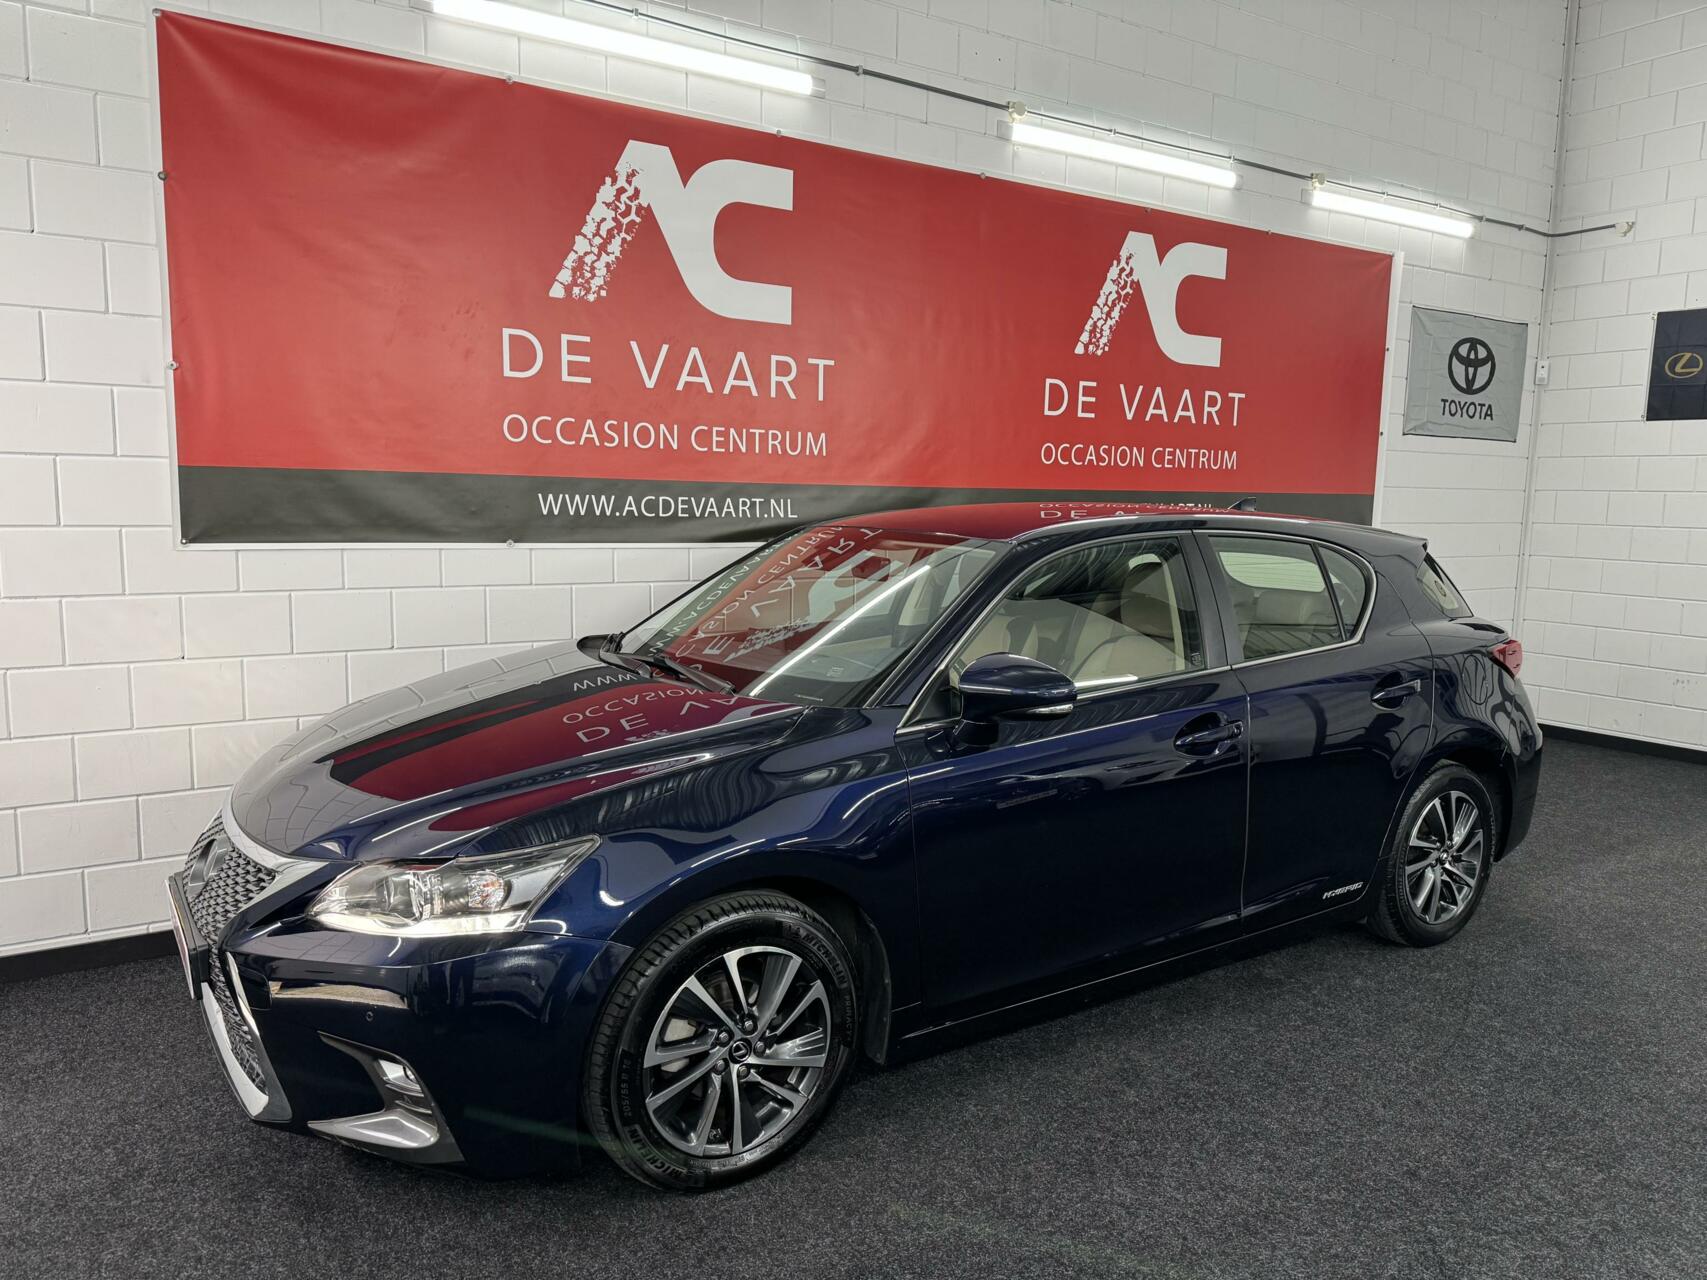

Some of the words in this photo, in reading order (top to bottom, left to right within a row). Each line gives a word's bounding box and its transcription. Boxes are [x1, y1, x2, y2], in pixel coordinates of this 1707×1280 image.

[548, 139, 794, 325] AC
[1074, 230, 1228, 367] AC
[502, 327, 593, 384] DE
[629, 340, 835, 401] VAART
[1043, 377, 1097, 419] DE
[1119, 383, 1246, 427] VAART
[1440, 398, 1494, 421] TOYOTA
[502, 413, 679, 450] OCCASION
[690, 425, 828, 457] CENTRUM
[1040, 442, 1144, 467] OCCASION
[1151, 447, 1237, 470] CENTRUM
[538, 493, 798, 519] WWW.ACDEVAART.NL
